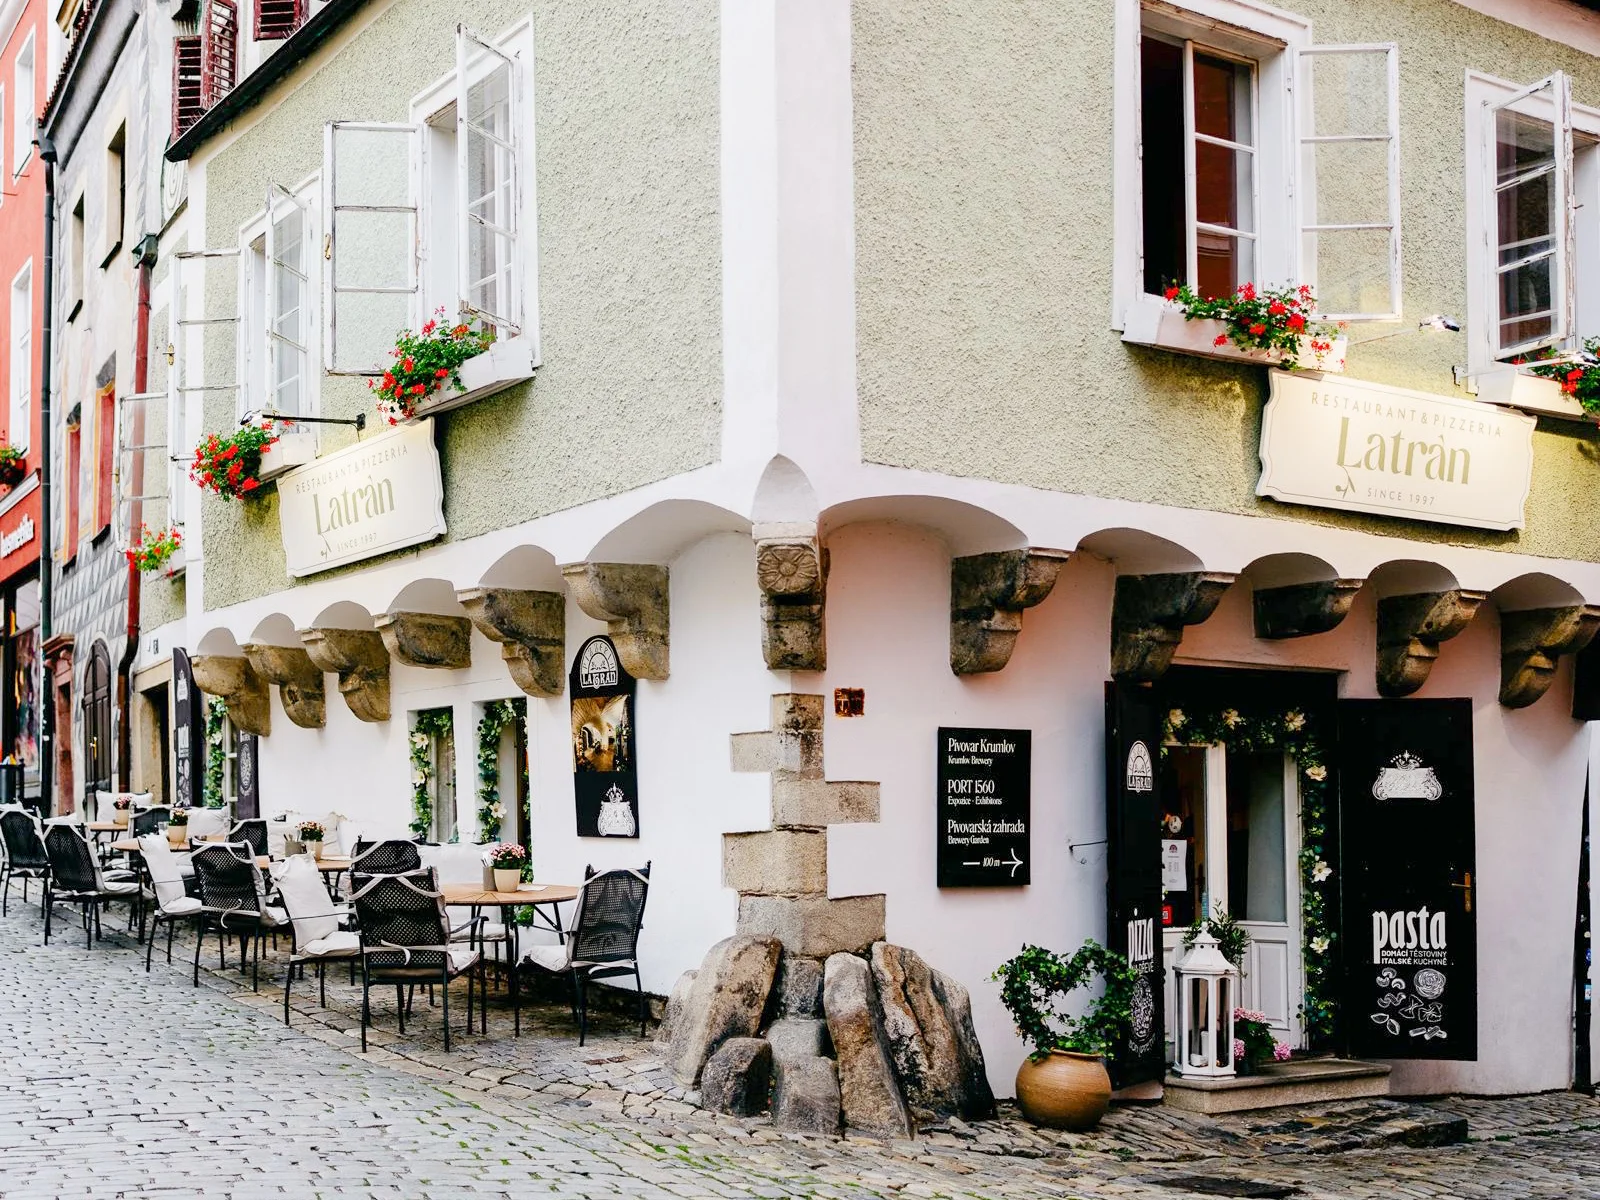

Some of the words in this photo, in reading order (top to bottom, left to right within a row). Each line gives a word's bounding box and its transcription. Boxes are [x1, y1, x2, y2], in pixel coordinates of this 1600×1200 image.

[1367, 487, 1402, 501] SINCE
[1409, 493, 1435, 507] 1997
[948, 737, 979, 753] Pivovar
[980, 738, 1016, 754] Krumlov
[948, 754, 971, 765] Krumlov
[971, 755, 993, 767] Brewery
[947, 779, 973, 794] PORT
[975, 779, 995, 794] 1560
[947, 819, 992, 834] Pivovarská
[993, 819, 1025, 834] zahrada
[948, 835, 970, 847] Brewery
[970, 835, 989, 845] Garden
[1372, 905, 1447, 965] pasta
[1381, 948, 1409, 957] DOMÁCÍ
[1409, 949, 1448, 958] TĚSTOVINY
[1381, 957, 1412, 965] ITALSKÉ
[1413, 957, 1448, 966] KUCHYNĚ
